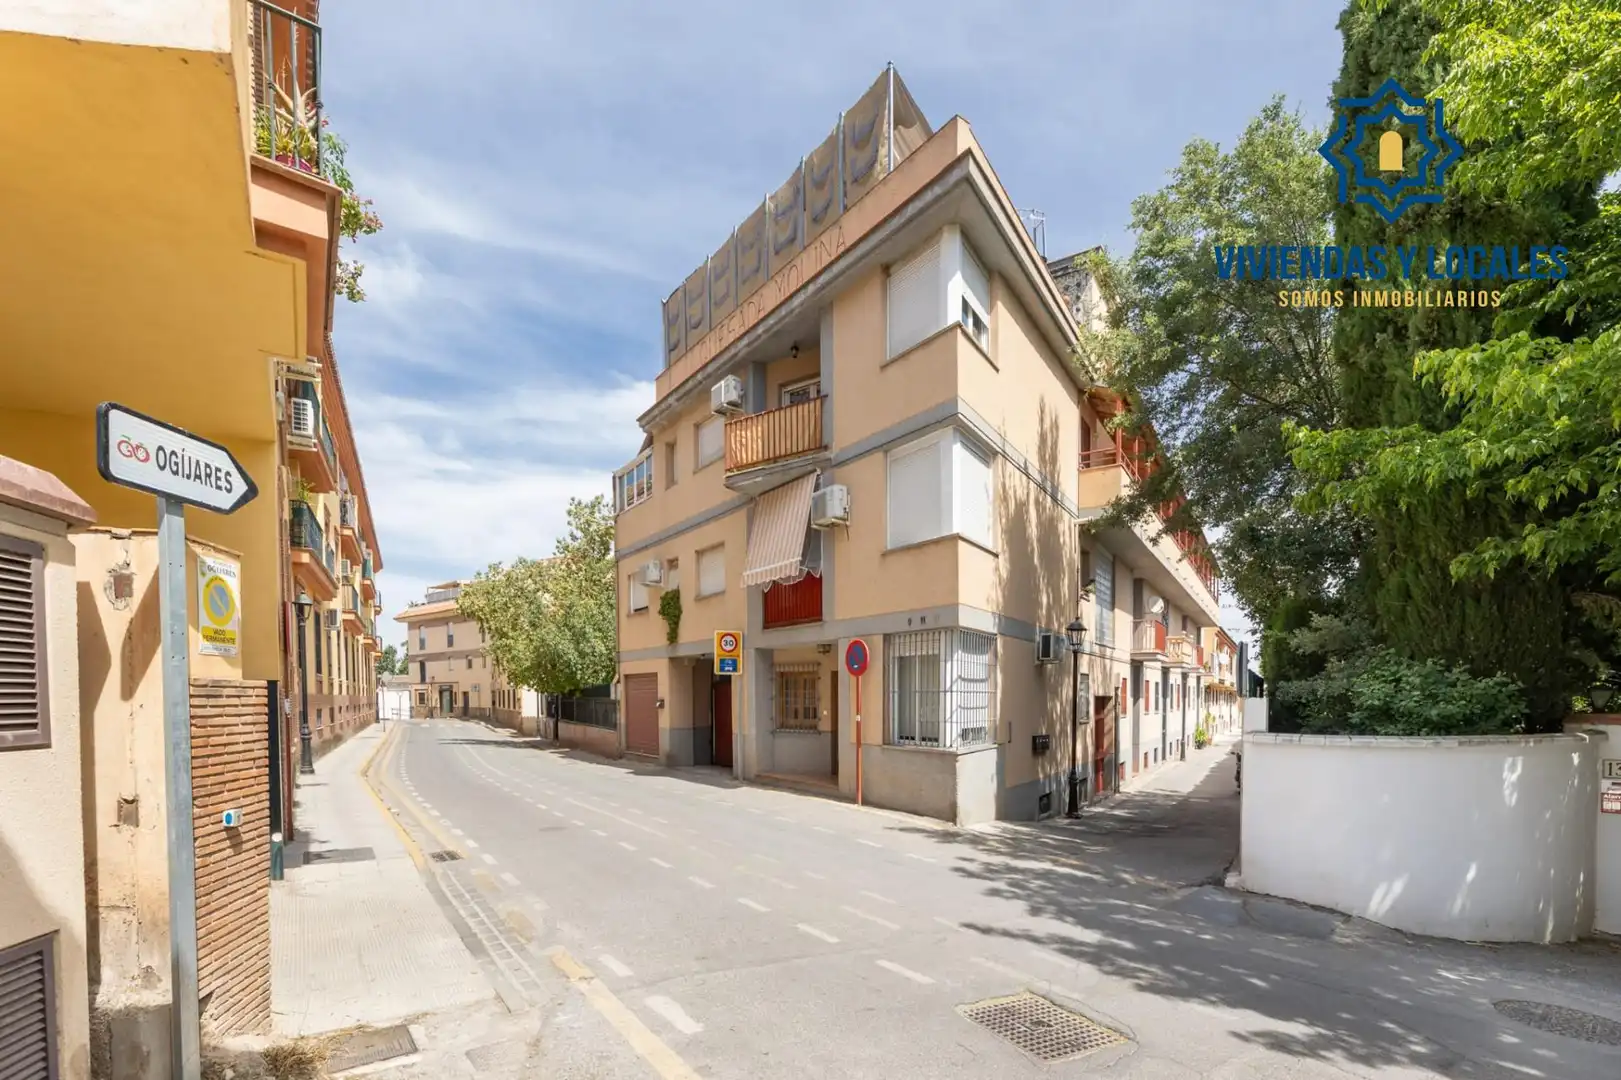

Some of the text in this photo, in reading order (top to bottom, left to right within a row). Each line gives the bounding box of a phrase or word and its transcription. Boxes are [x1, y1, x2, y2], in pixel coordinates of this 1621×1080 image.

[775, 226, 847, 299] MOLINA
[155, 445, 233, 494] OGÍJARES
[723, 639, 734, 647] 30
